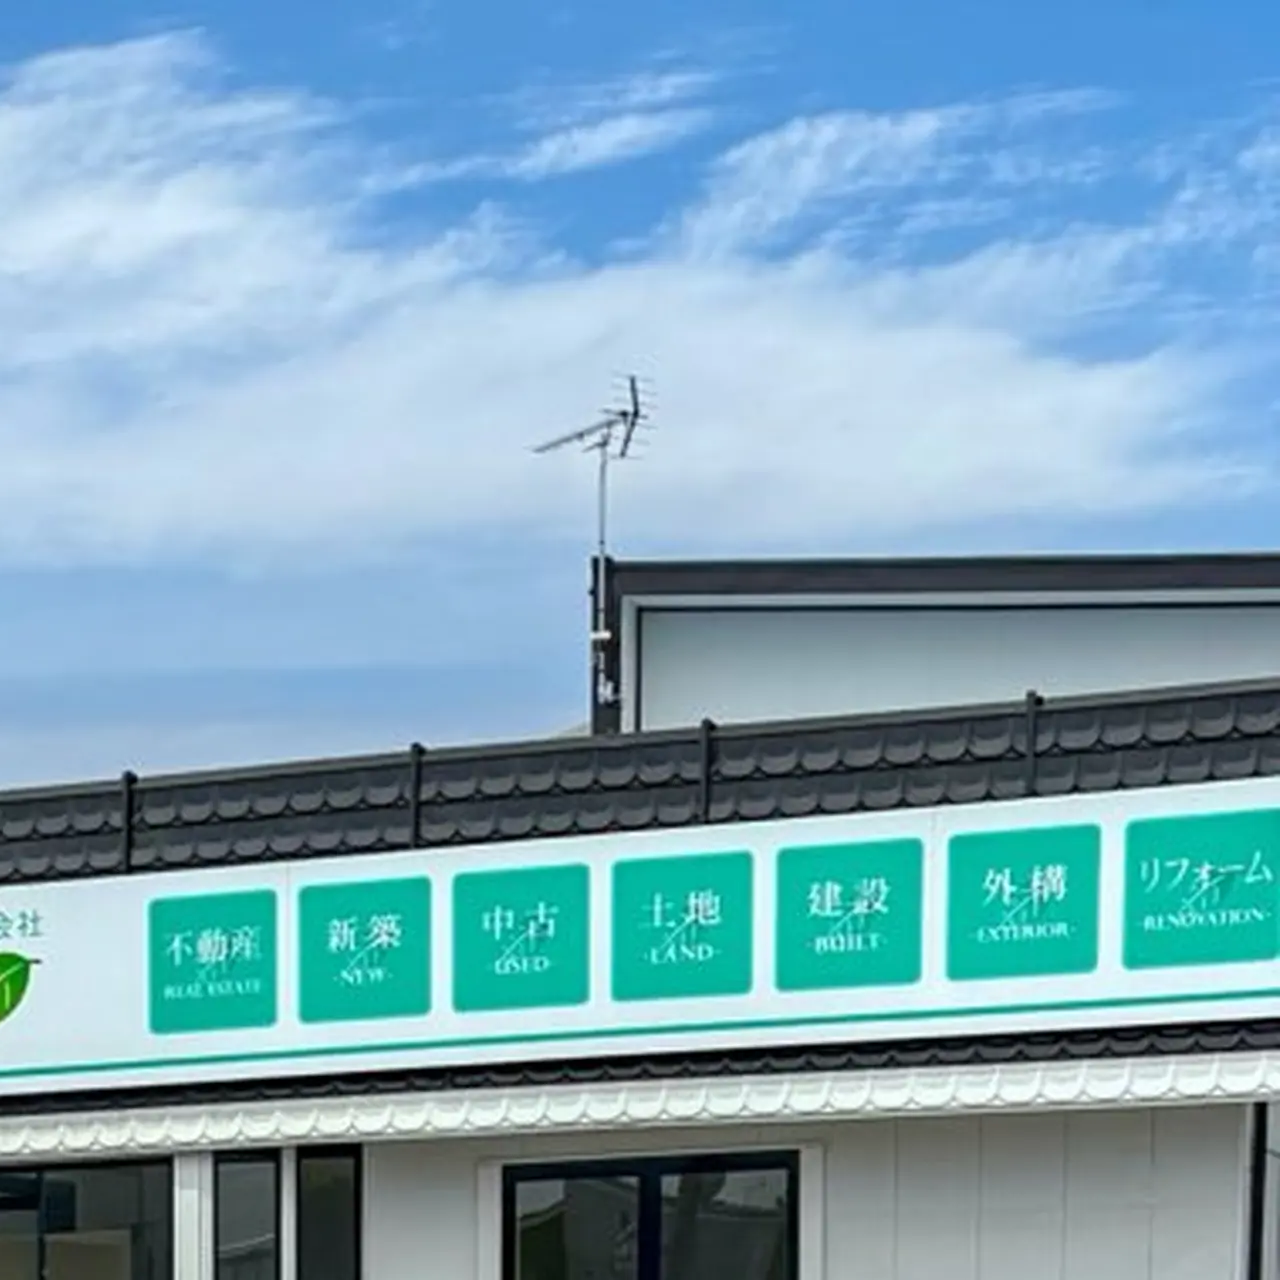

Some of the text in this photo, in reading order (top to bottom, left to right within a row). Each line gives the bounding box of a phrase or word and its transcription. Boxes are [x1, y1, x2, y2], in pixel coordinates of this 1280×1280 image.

[982, 864, 1068, 908] 外構
[1141, 850, 1273, 893] リフォーム
[639, 889, 722, 928] 土地
[807, 878, 889, 917] 建設
[328, 915, 403, 952] 新築
[482, 901, 559, 941] 中古
[164, 925, 262, 966] 不動産
